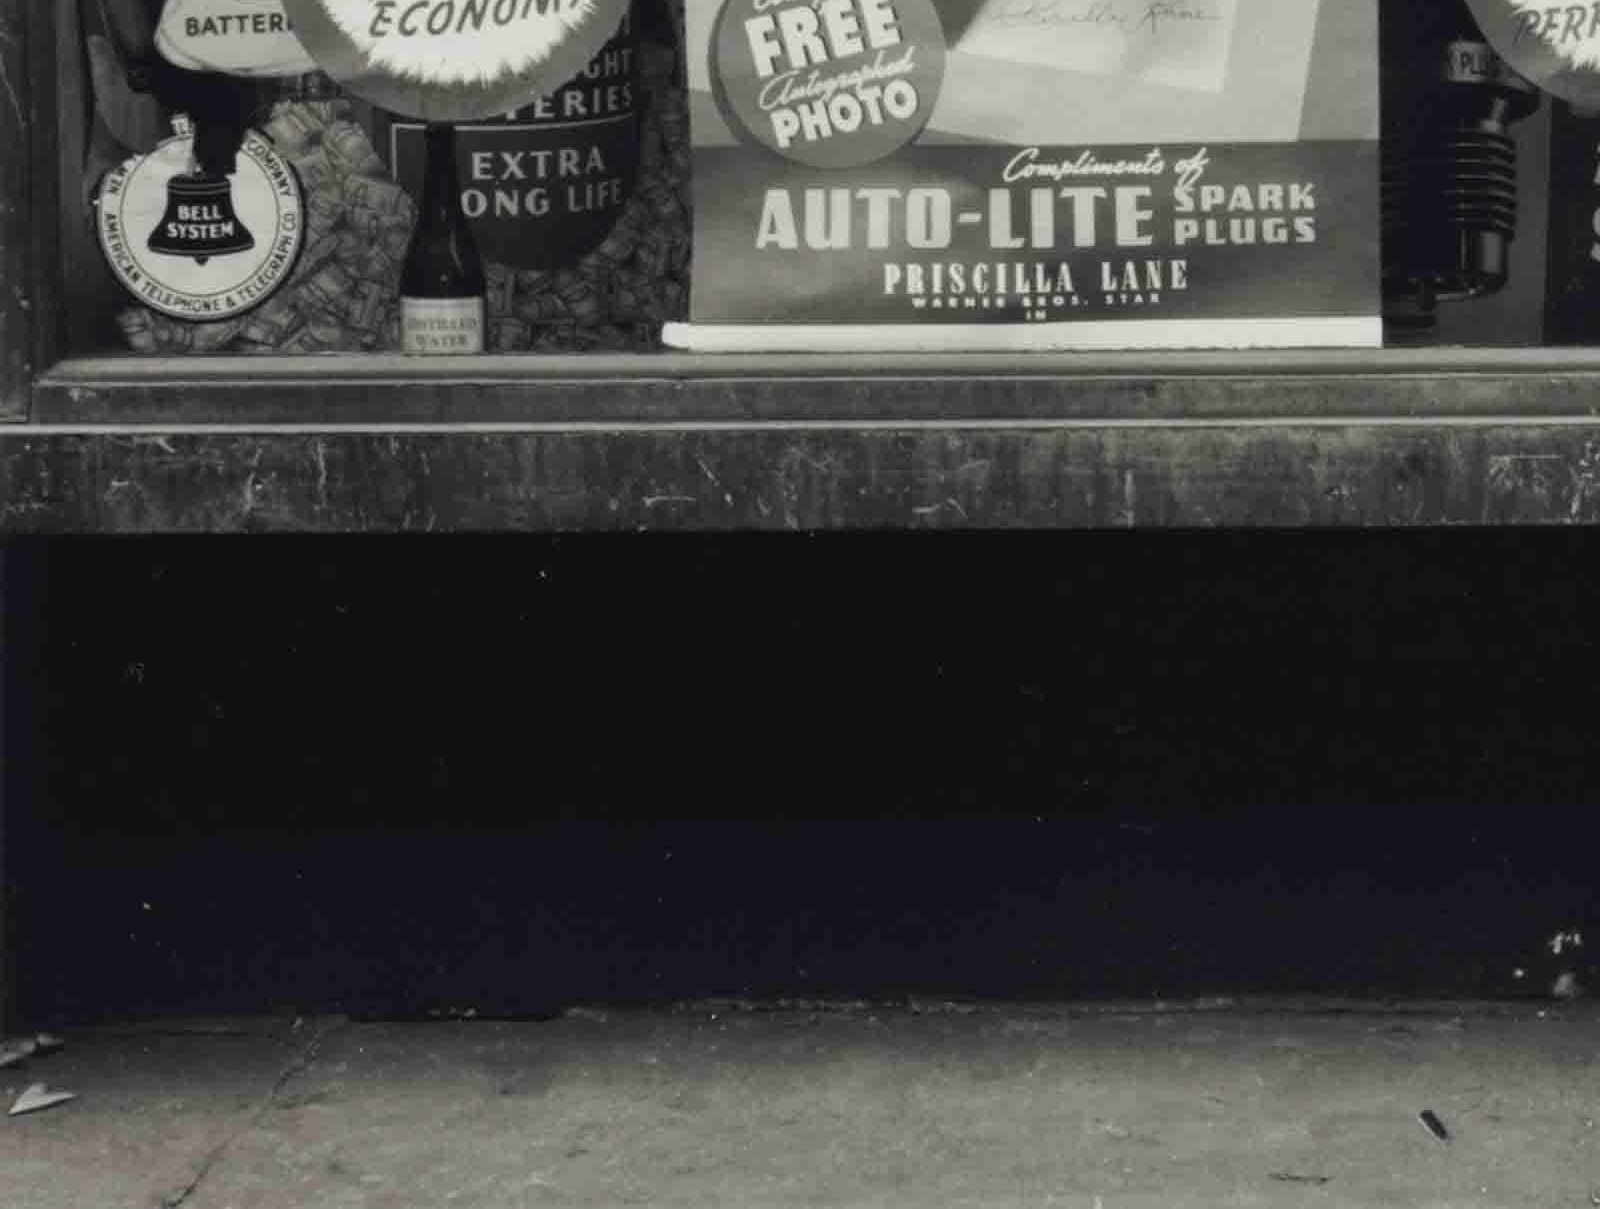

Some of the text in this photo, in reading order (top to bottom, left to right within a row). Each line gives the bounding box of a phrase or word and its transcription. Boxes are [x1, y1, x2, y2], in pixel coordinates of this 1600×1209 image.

[769, 78, 918, 149] PHOTO
[471, 145, 605, 180] EXTRA
[1002, 147, 1211, 189] Compliments of
[177, 204, 223, 221] BELL
[460, 177, 622, 219] ONG LIFE
[1172, 182, 1318, 212] SPARK
[167, 220, 235, 239] SYSTEM
[755, 186, 1154, 250] AUTO-LITE
[1172, 216, 1318, 247] PLUGS
[105, 213, 140, 283] AMERICAN
[140, 281, 222, 313] TELEPHONE
[225, 295, 237, 309] &
[237, 238, 292, 299] TELEGRAPH
[883, 258, 1189, 296] PRISCILLA LANE
[1105, 292, 1162, 306] STAR
